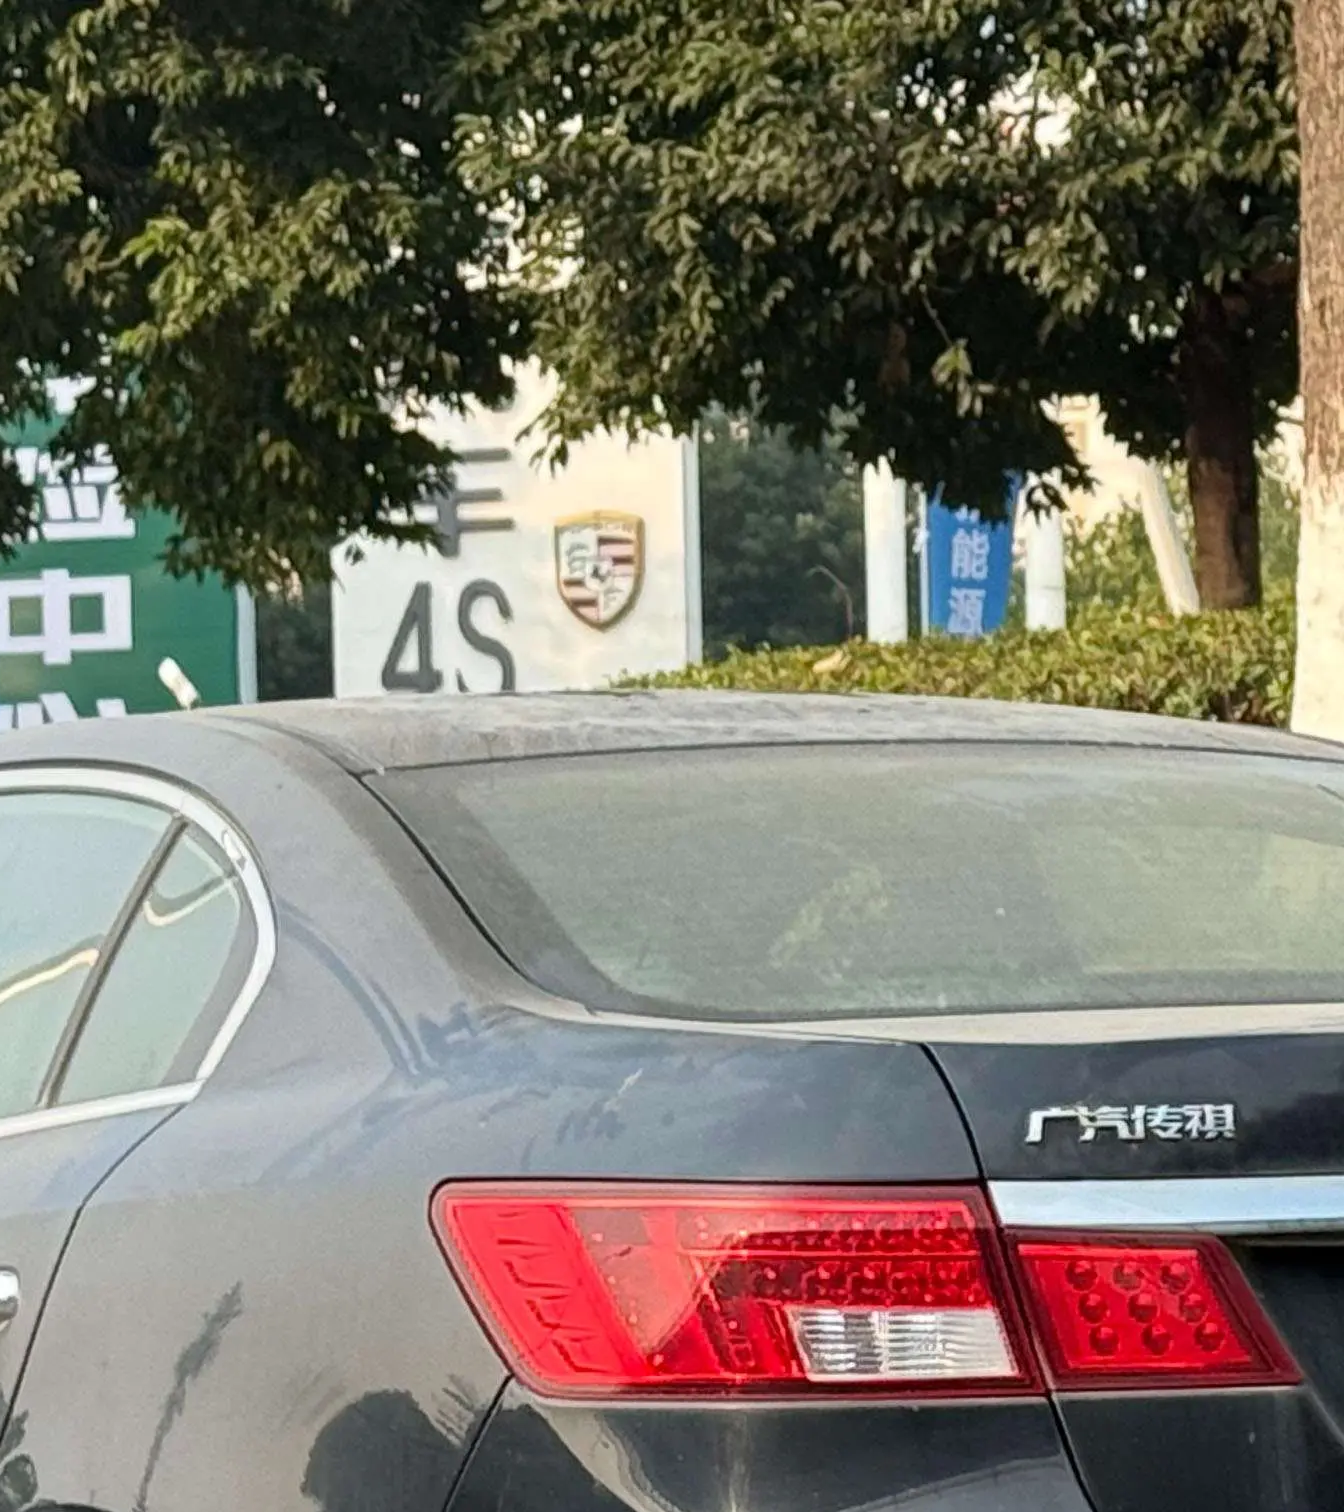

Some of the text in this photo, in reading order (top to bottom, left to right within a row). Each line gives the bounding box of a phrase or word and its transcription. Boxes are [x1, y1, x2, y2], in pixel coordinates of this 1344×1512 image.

[381, 577, 516, 693] 4S
[1024, 1103, 1236, 1144] 广汽传祺
